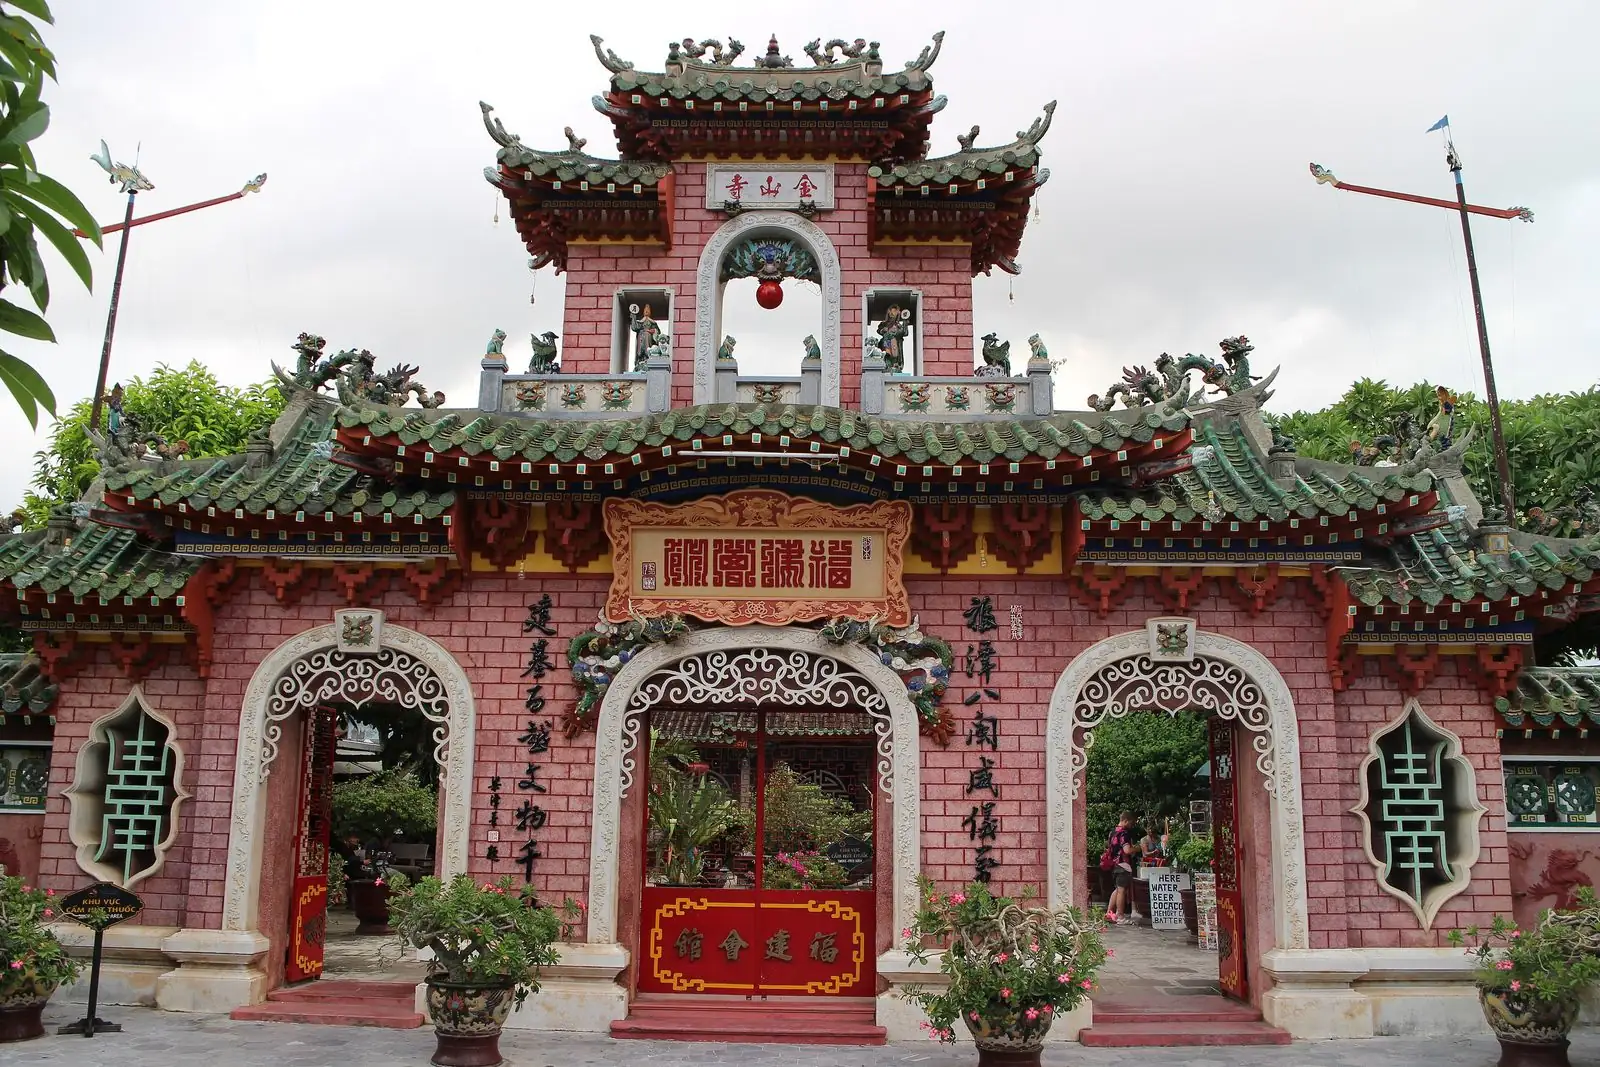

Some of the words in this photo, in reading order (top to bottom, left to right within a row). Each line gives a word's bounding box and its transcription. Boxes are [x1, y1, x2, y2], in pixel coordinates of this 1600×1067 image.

[725, 173, 818, 199] 金山寺
[664, 538, 852, 589] 福建會館
[517, 593, 557, 909] 建基百越文物千
[1159, 874, 1181, 882] HERE
[674, 928, 839, 963] 福建會館
